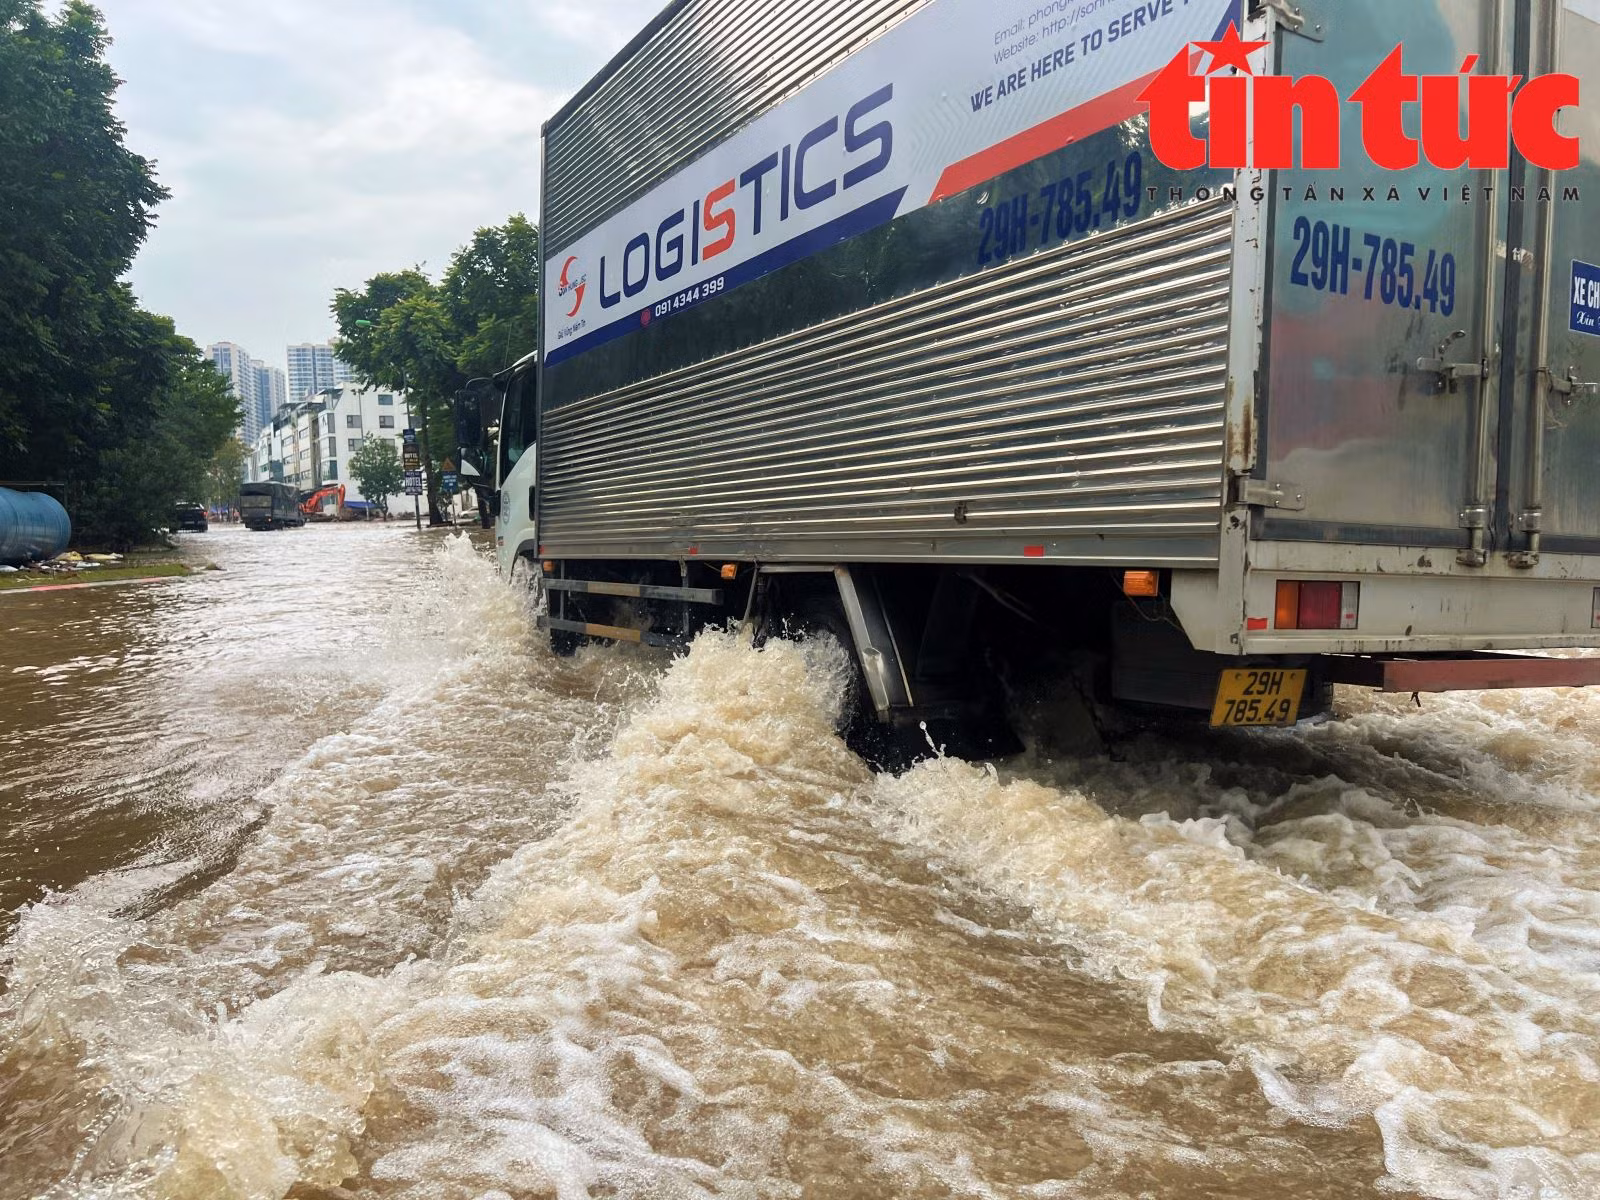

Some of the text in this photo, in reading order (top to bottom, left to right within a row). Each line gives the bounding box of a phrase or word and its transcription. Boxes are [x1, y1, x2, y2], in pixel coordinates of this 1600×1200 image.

[993, 32, 1038, 65] Website:
[994, 18, 1025, 45] Email:
[970, 0, 1174, 113] WE ARE HERE TO SERVE
[600, 83, 894, 309] LOGISTICS
[977, 151, 1143, 266] 29H-785.49
[1290, 215, 1456, 317] 29H-785.49
[655, 276, 725, 317] 091 4344 399
[1573, 275, 1587, 306] XE
[1242, 671, 1285, 696] 29H
[1223, 699, 1292, 723] 785.49
